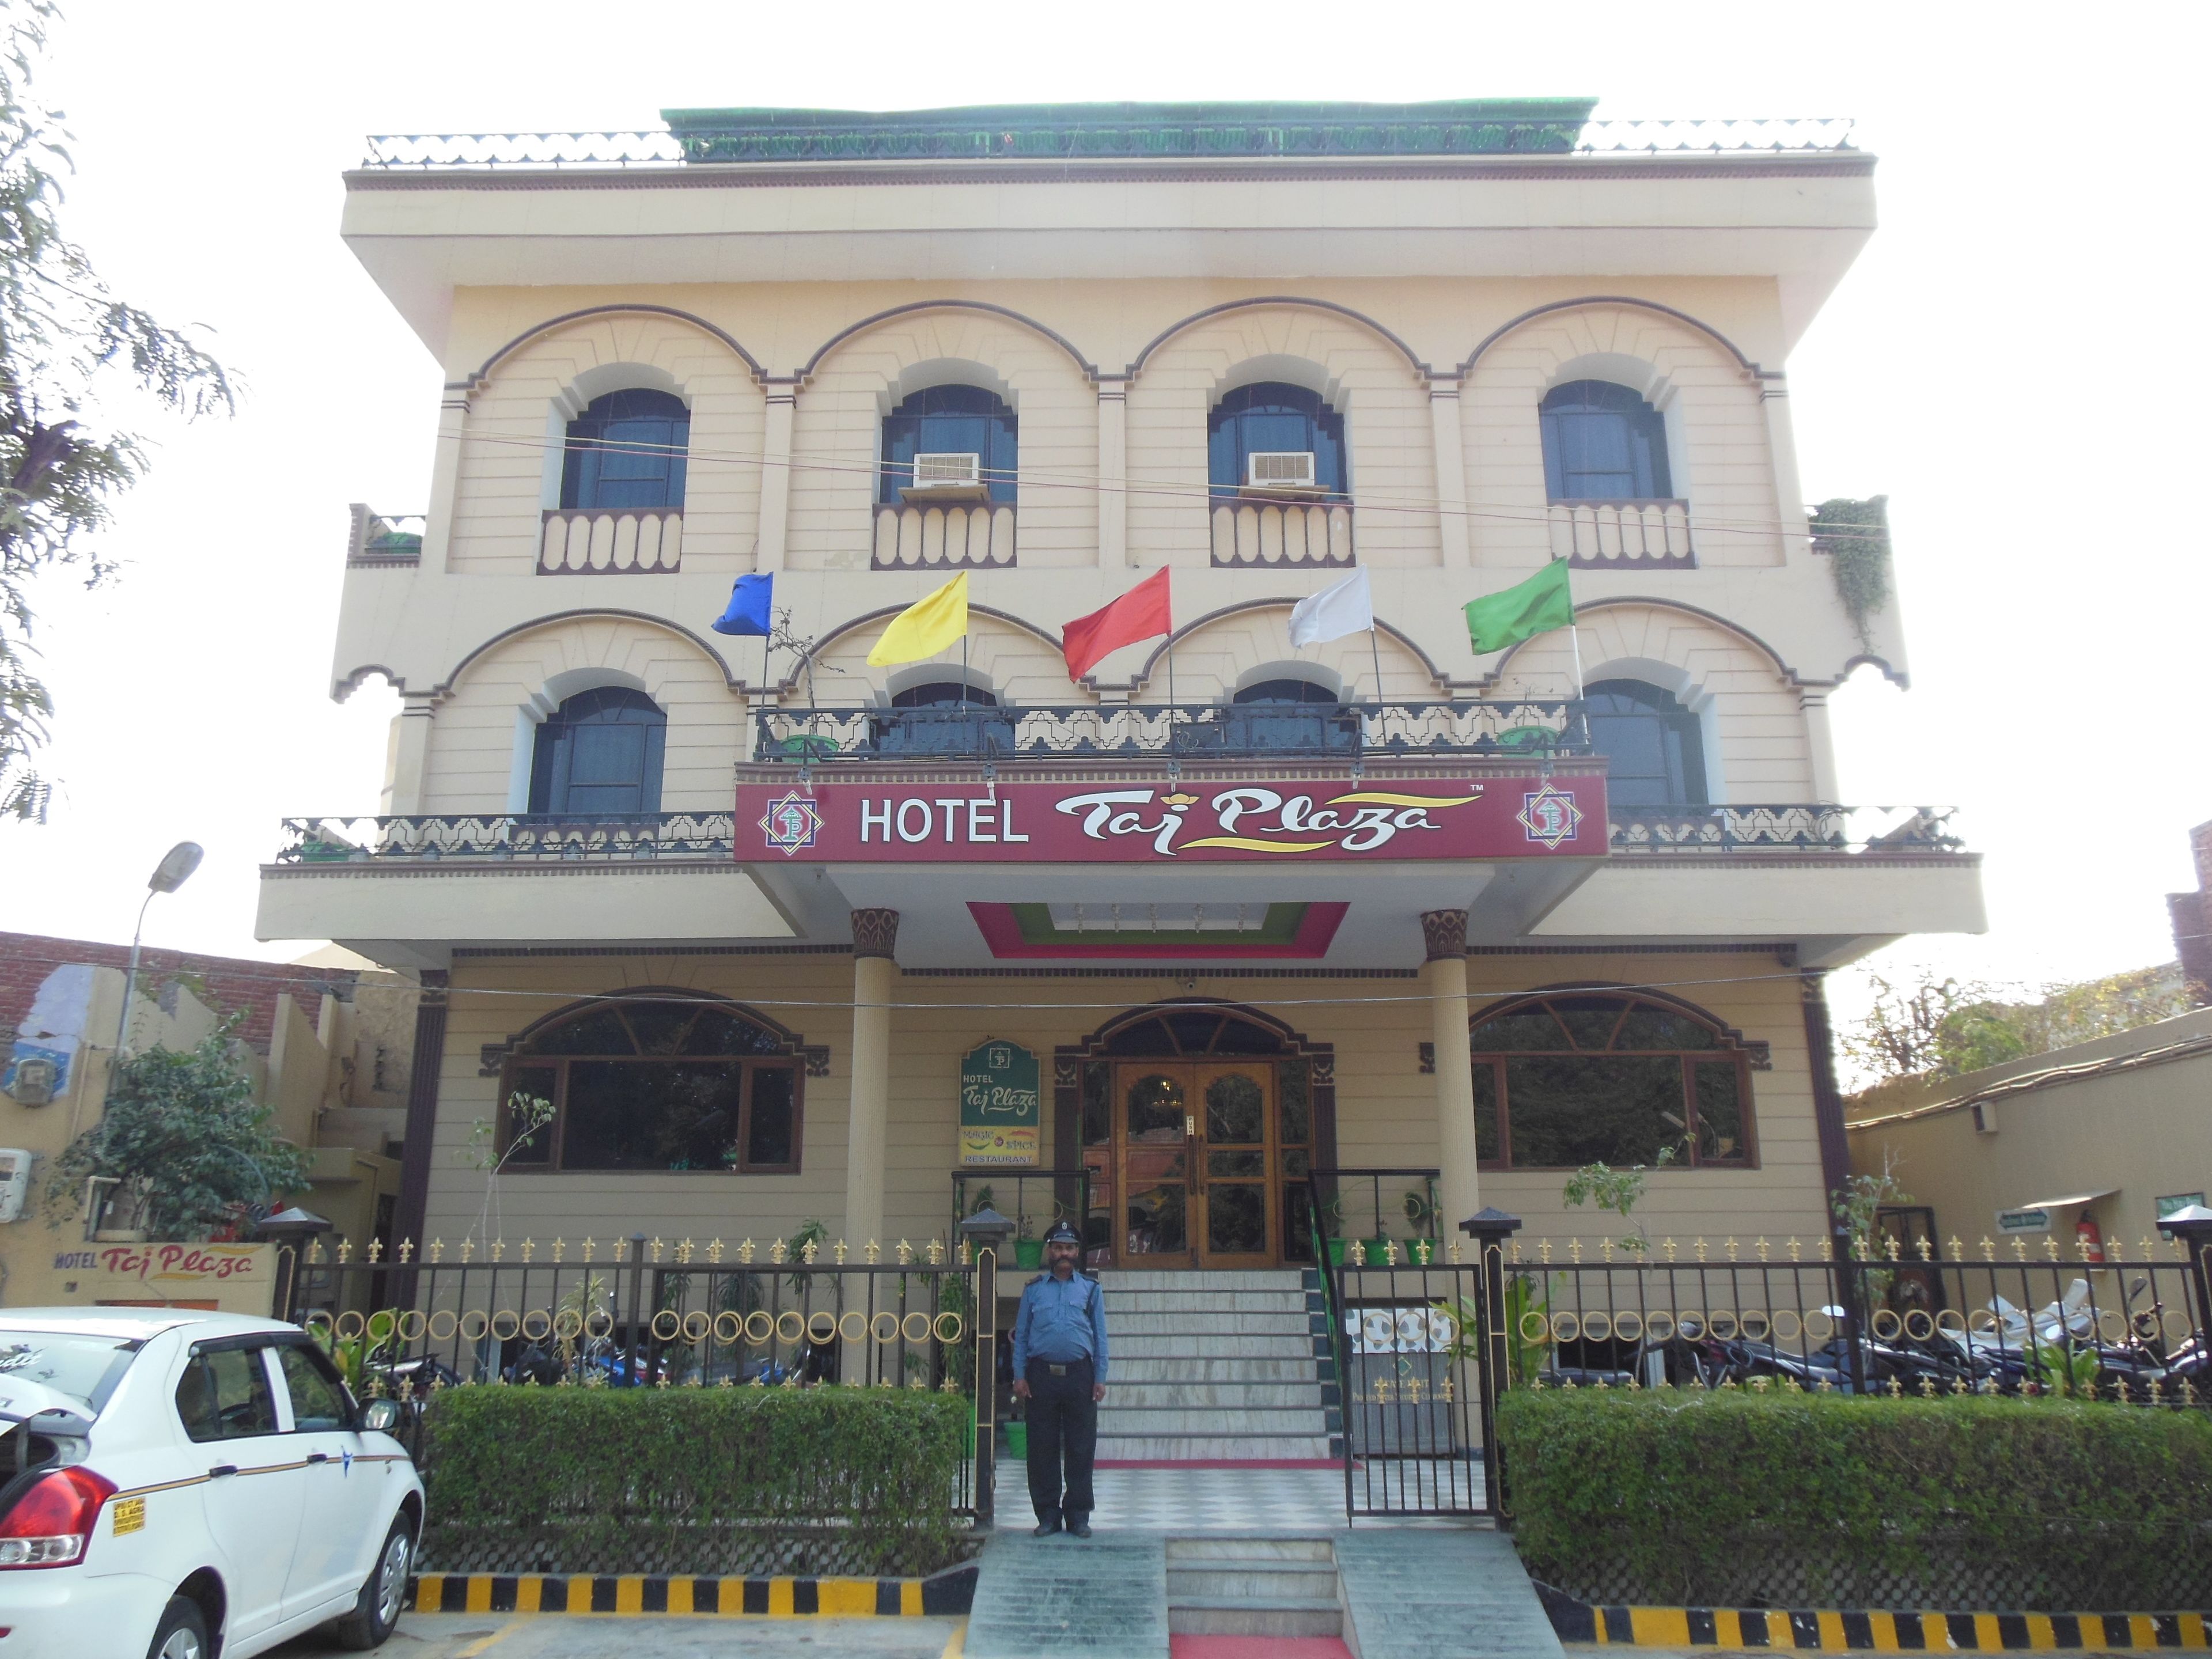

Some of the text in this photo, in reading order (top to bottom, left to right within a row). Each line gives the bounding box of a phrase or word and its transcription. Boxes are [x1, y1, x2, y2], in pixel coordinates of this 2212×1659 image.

[861, 798, 1029, 843] HOTEL
[1055, 790, 1189, 855] Taj
[1211, 787, 1442, 851] Plaza
[963, 1075, 993, 1083] HOTEL
[963, 1085, 1036, 1116] Taj Plaza
[54, 1245, 252, 1279] HOTEL Taj Plaza
